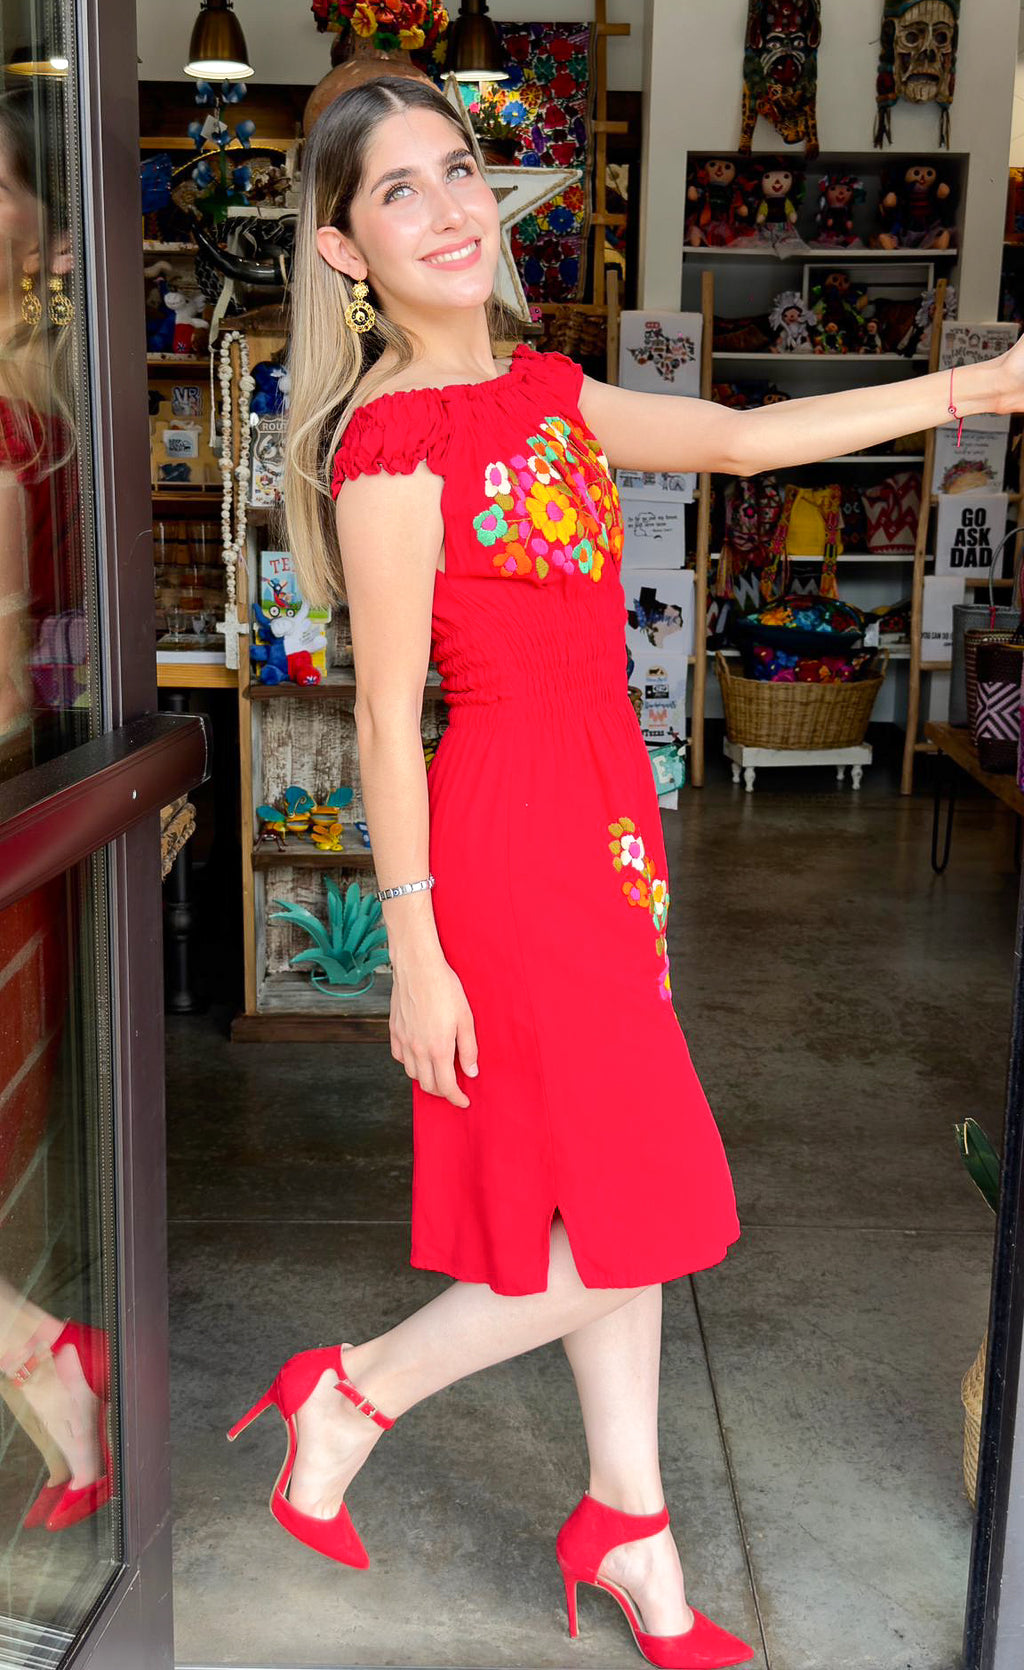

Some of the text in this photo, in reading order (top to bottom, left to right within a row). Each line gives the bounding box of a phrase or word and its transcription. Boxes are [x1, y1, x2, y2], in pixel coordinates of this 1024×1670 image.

[262, 422, 286, 431] ROU
[961, 508, 986, 527] GO
[954, 528, 991, 547] ASK
[270, 557, 296, 575] TE
[950, 548, 992, 568] DAD
